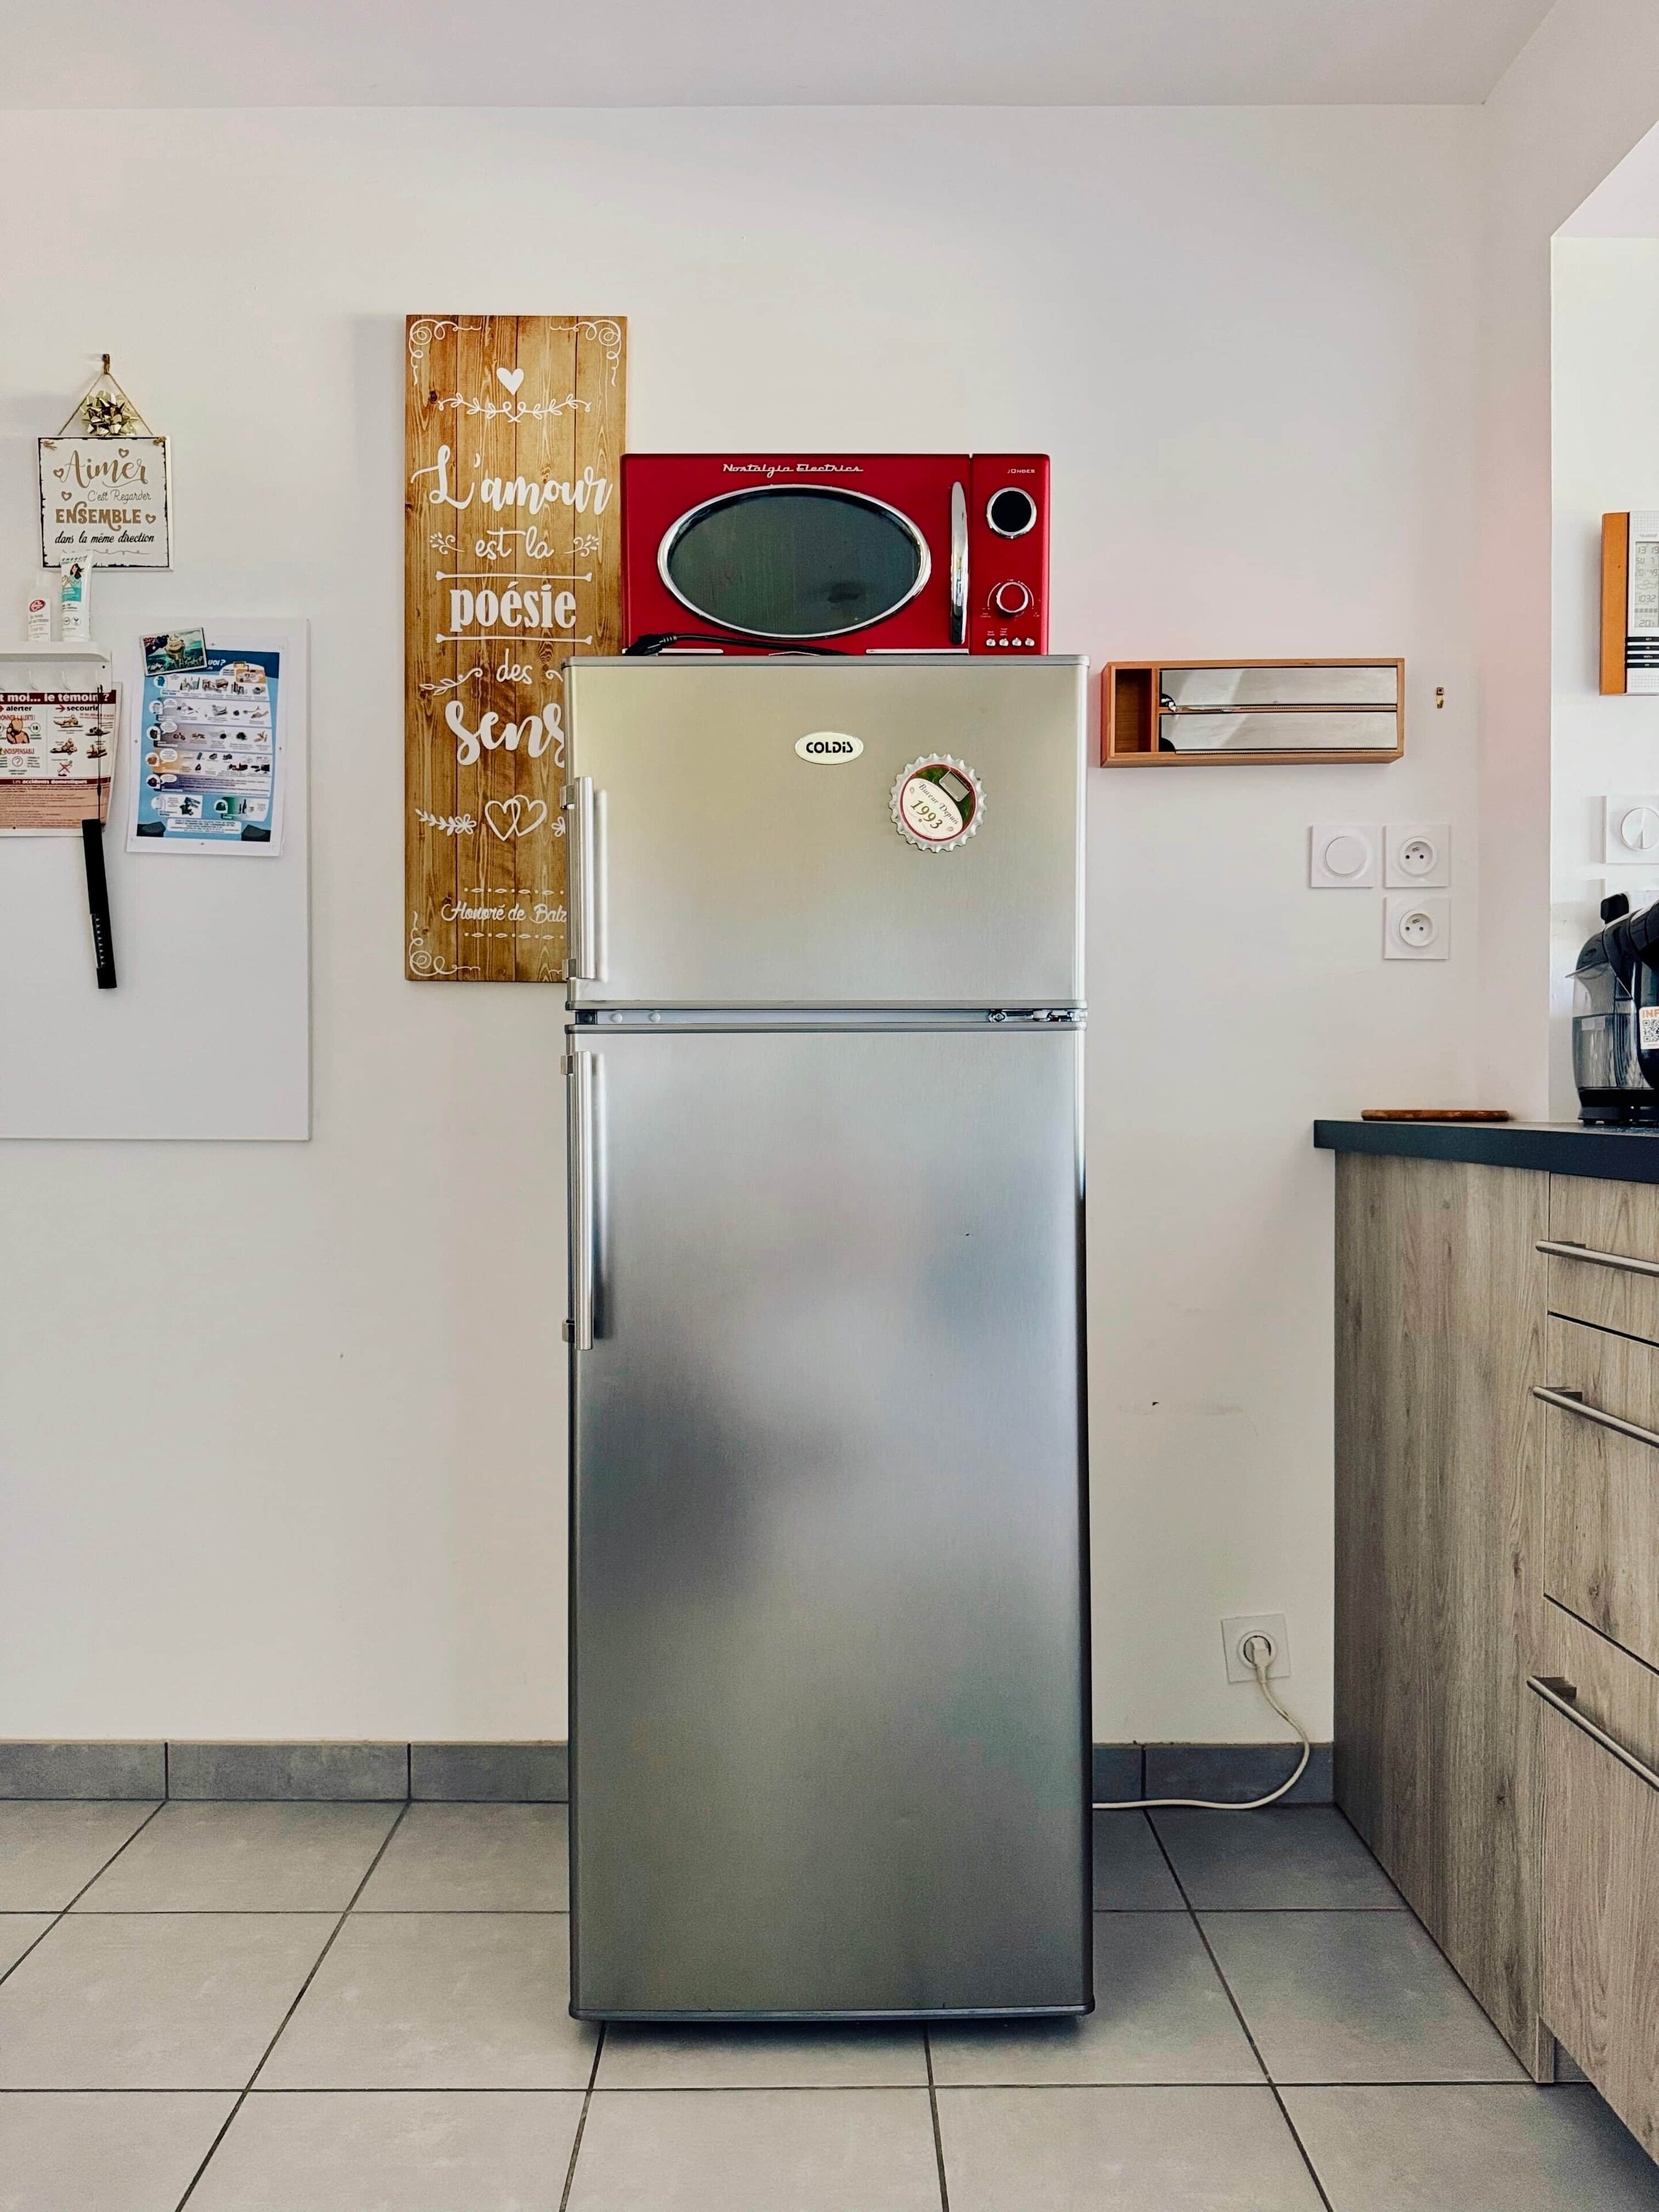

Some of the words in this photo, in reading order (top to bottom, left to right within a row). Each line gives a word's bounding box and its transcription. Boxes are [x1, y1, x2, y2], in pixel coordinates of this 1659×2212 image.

[60, 450, 148, 488] Aimer
[410, 444, 613, 516] L'amour
[722, 464, 794, 478] Nostalgia
[796, 464, 863, 472] Electrics
[88, 490, 109, 502] C'est
[110, 489, 151, 505] Regarder
[55, 501, 142, 531] ENSEMBLE
[55, 531, 74, 544] dans
[79, 531, 88, 544] la
[90, 532, 115, 543] même
[118, 530, 155, 543] direction
[475, 527, 527, 560] est
[525, 525, 555, 559] la
[450, 581, 576, 632] poésie
[496, 648, 533, 685] des
[7, 694, 41, 702] moi...
[44, 693, 55, 702] le
[58, 693, 99, 702] témoin
[103, 693, 110, 702] ?
[910, 800, 944, 829] 1993
[938, 802, 959, 825] Depuis
[441, 900, 506, 922] Honoré
[507, 903, 527, 922] de
